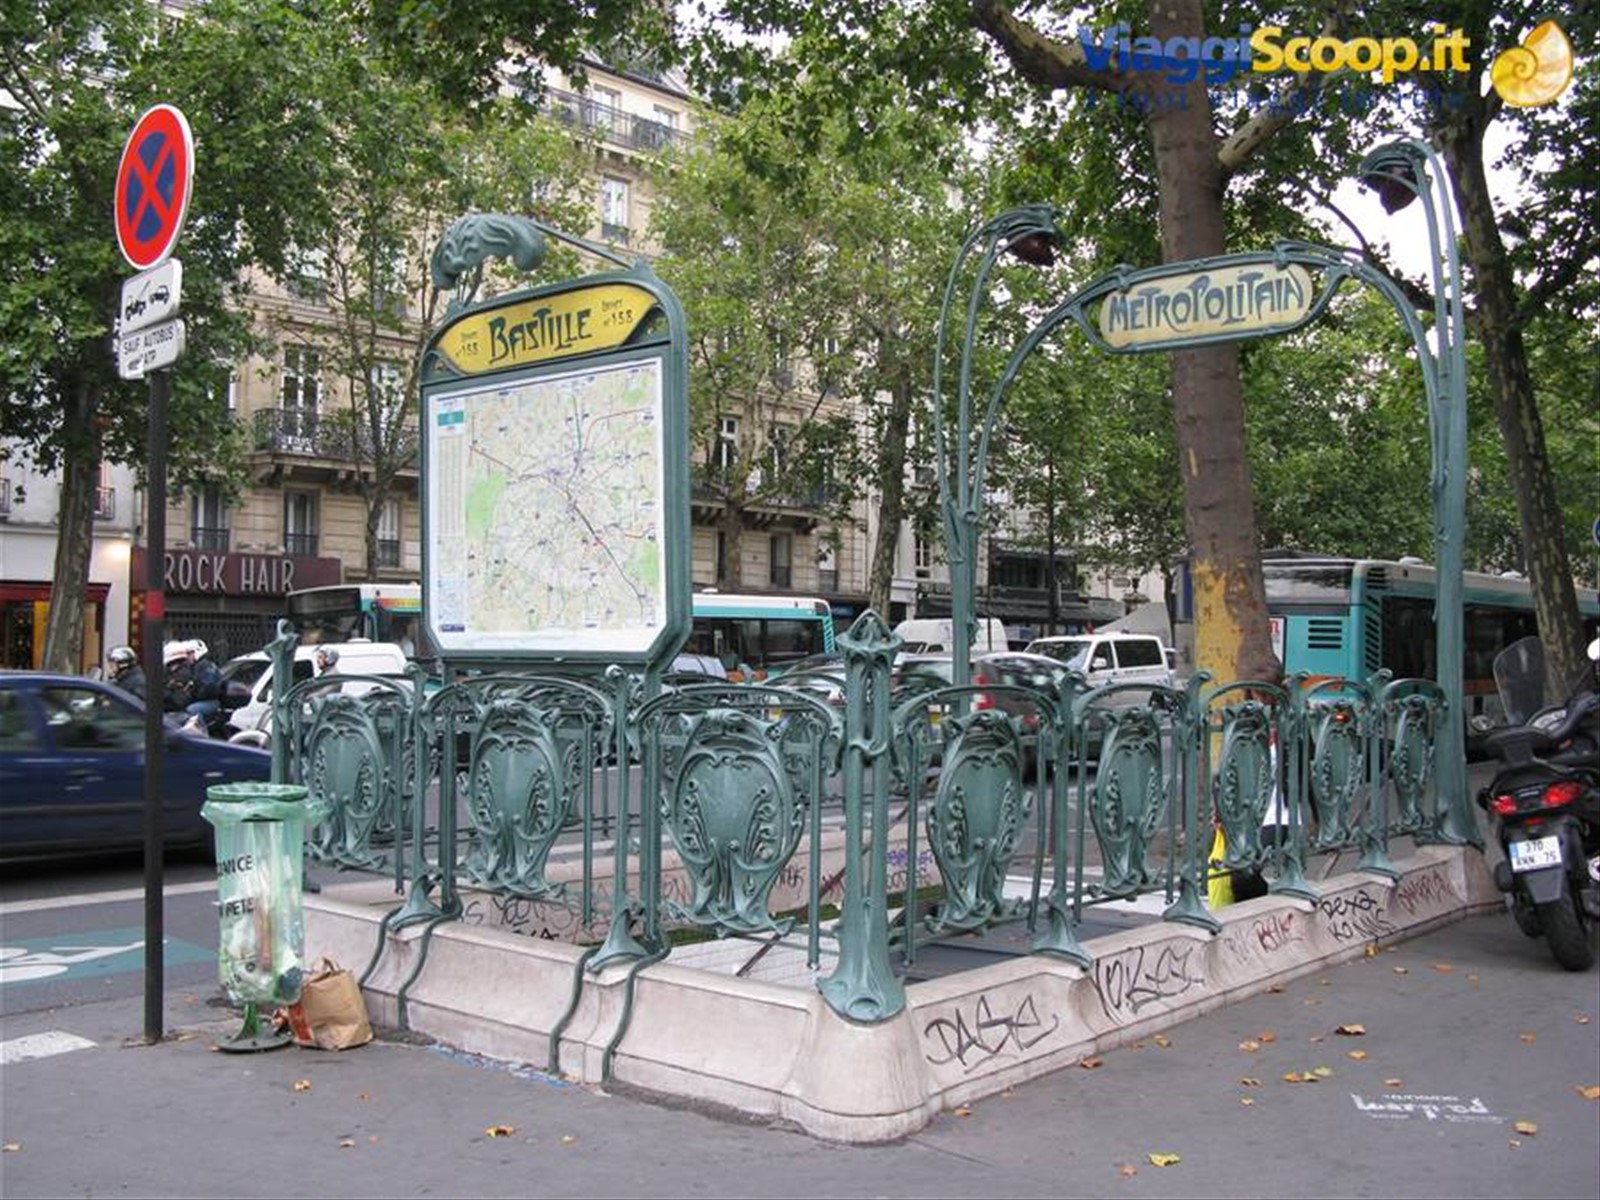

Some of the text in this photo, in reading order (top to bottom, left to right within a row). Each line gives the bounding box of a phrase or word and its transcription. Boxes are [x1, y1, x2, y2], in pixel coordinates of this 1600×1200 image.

[1107, 268, 1305, 333] METROPOLITAIN
[144, 325, 174, 347] AUTOBUS
[488, 304, 593, 365] BASTILLE
[163, 553, 295, 592] ROCK HAIR
